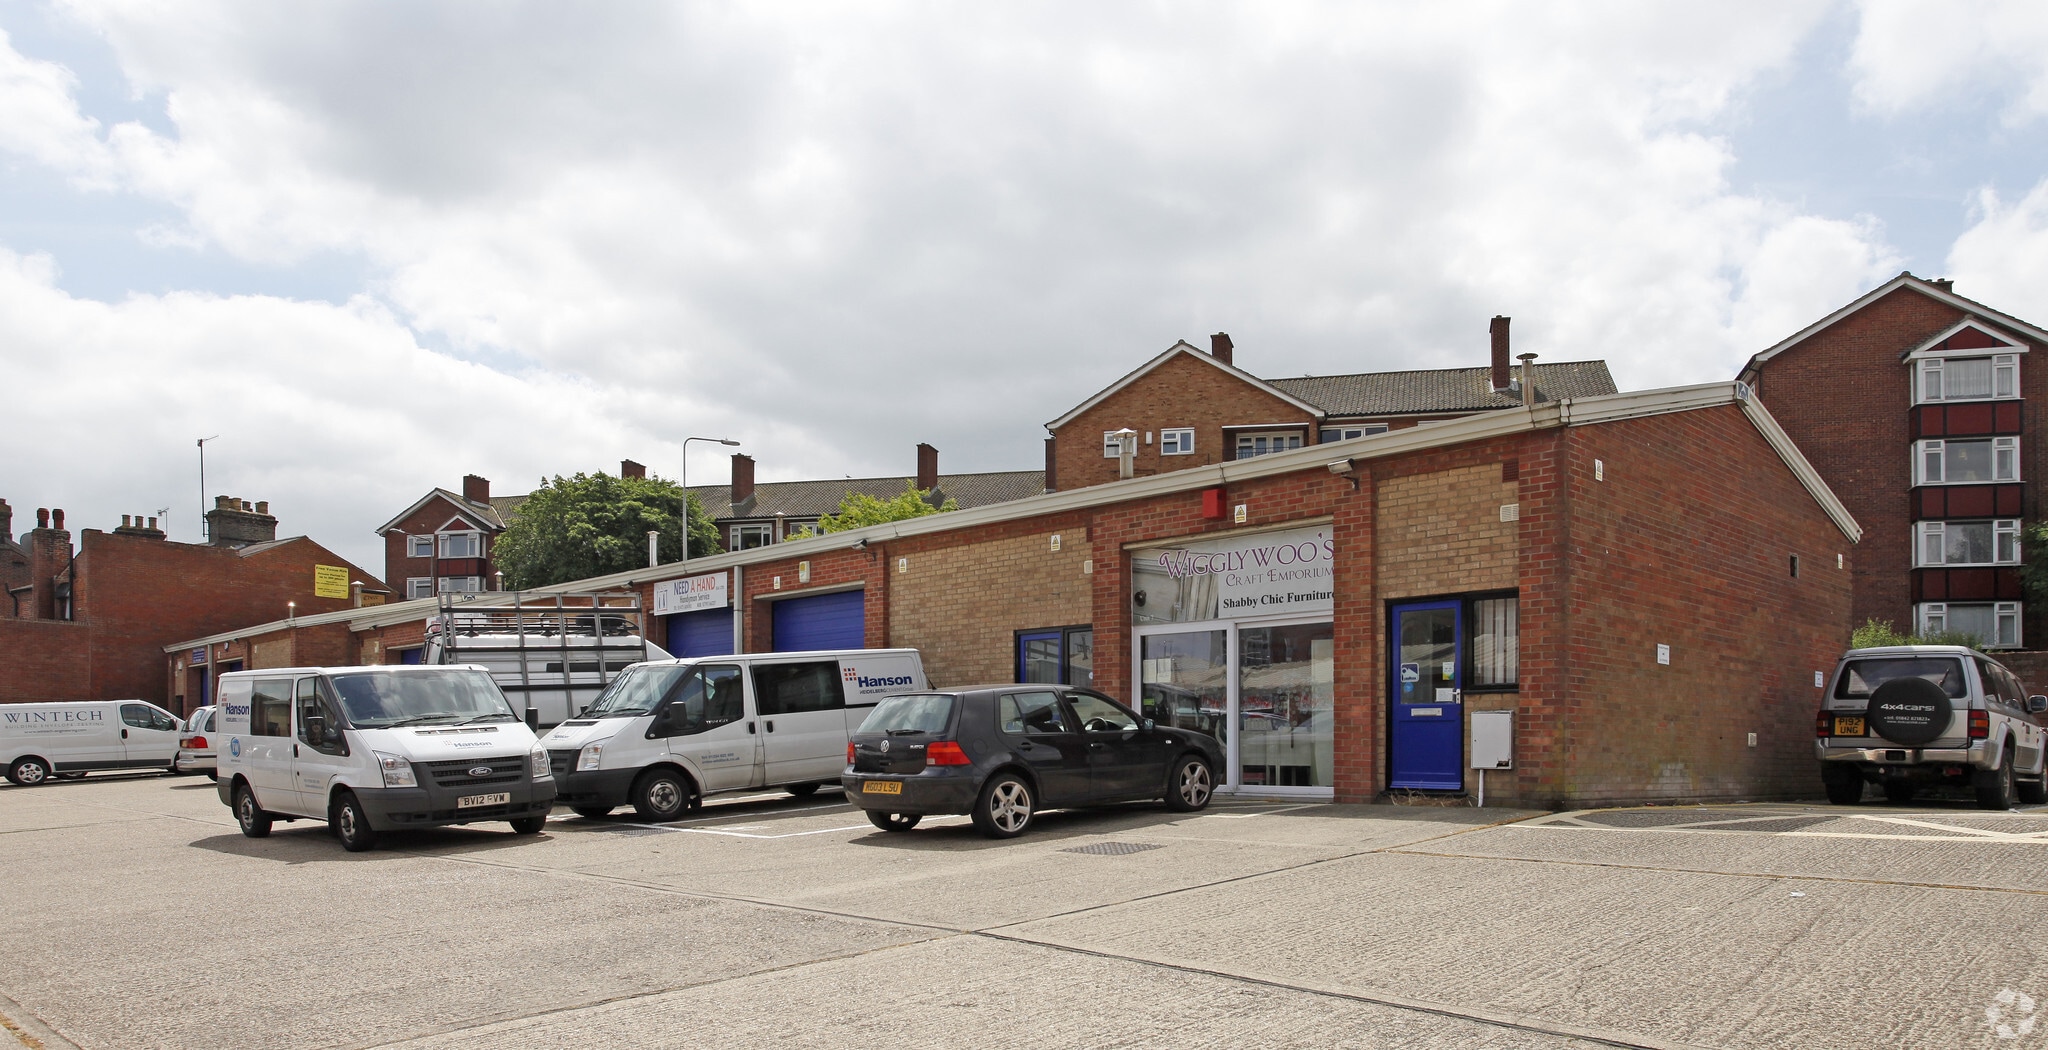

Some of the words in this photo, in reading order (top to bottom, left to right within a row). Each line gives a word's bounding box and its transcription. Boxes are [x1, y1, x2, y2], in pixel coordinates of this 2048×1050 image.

[674, 580, 689, 595] NEED
[690, 579, 696, 593] A
[697, 576, 716, 592] HAND
[1225, 573, 1264, 587] CRAFT
[1223, 598, 1258, 609] Shabby
[1261, 594, 1284, 605] Chic
[857, 676, 913, 687] Hanson
[225, 702, 250, 715] Hanson
[4, 710, 103, 723] WINTECH
[1838, 717, 1862, 726] P192
[1840, 726, 1859, 734] UNG
[464, 796, 485, 806] BV12
